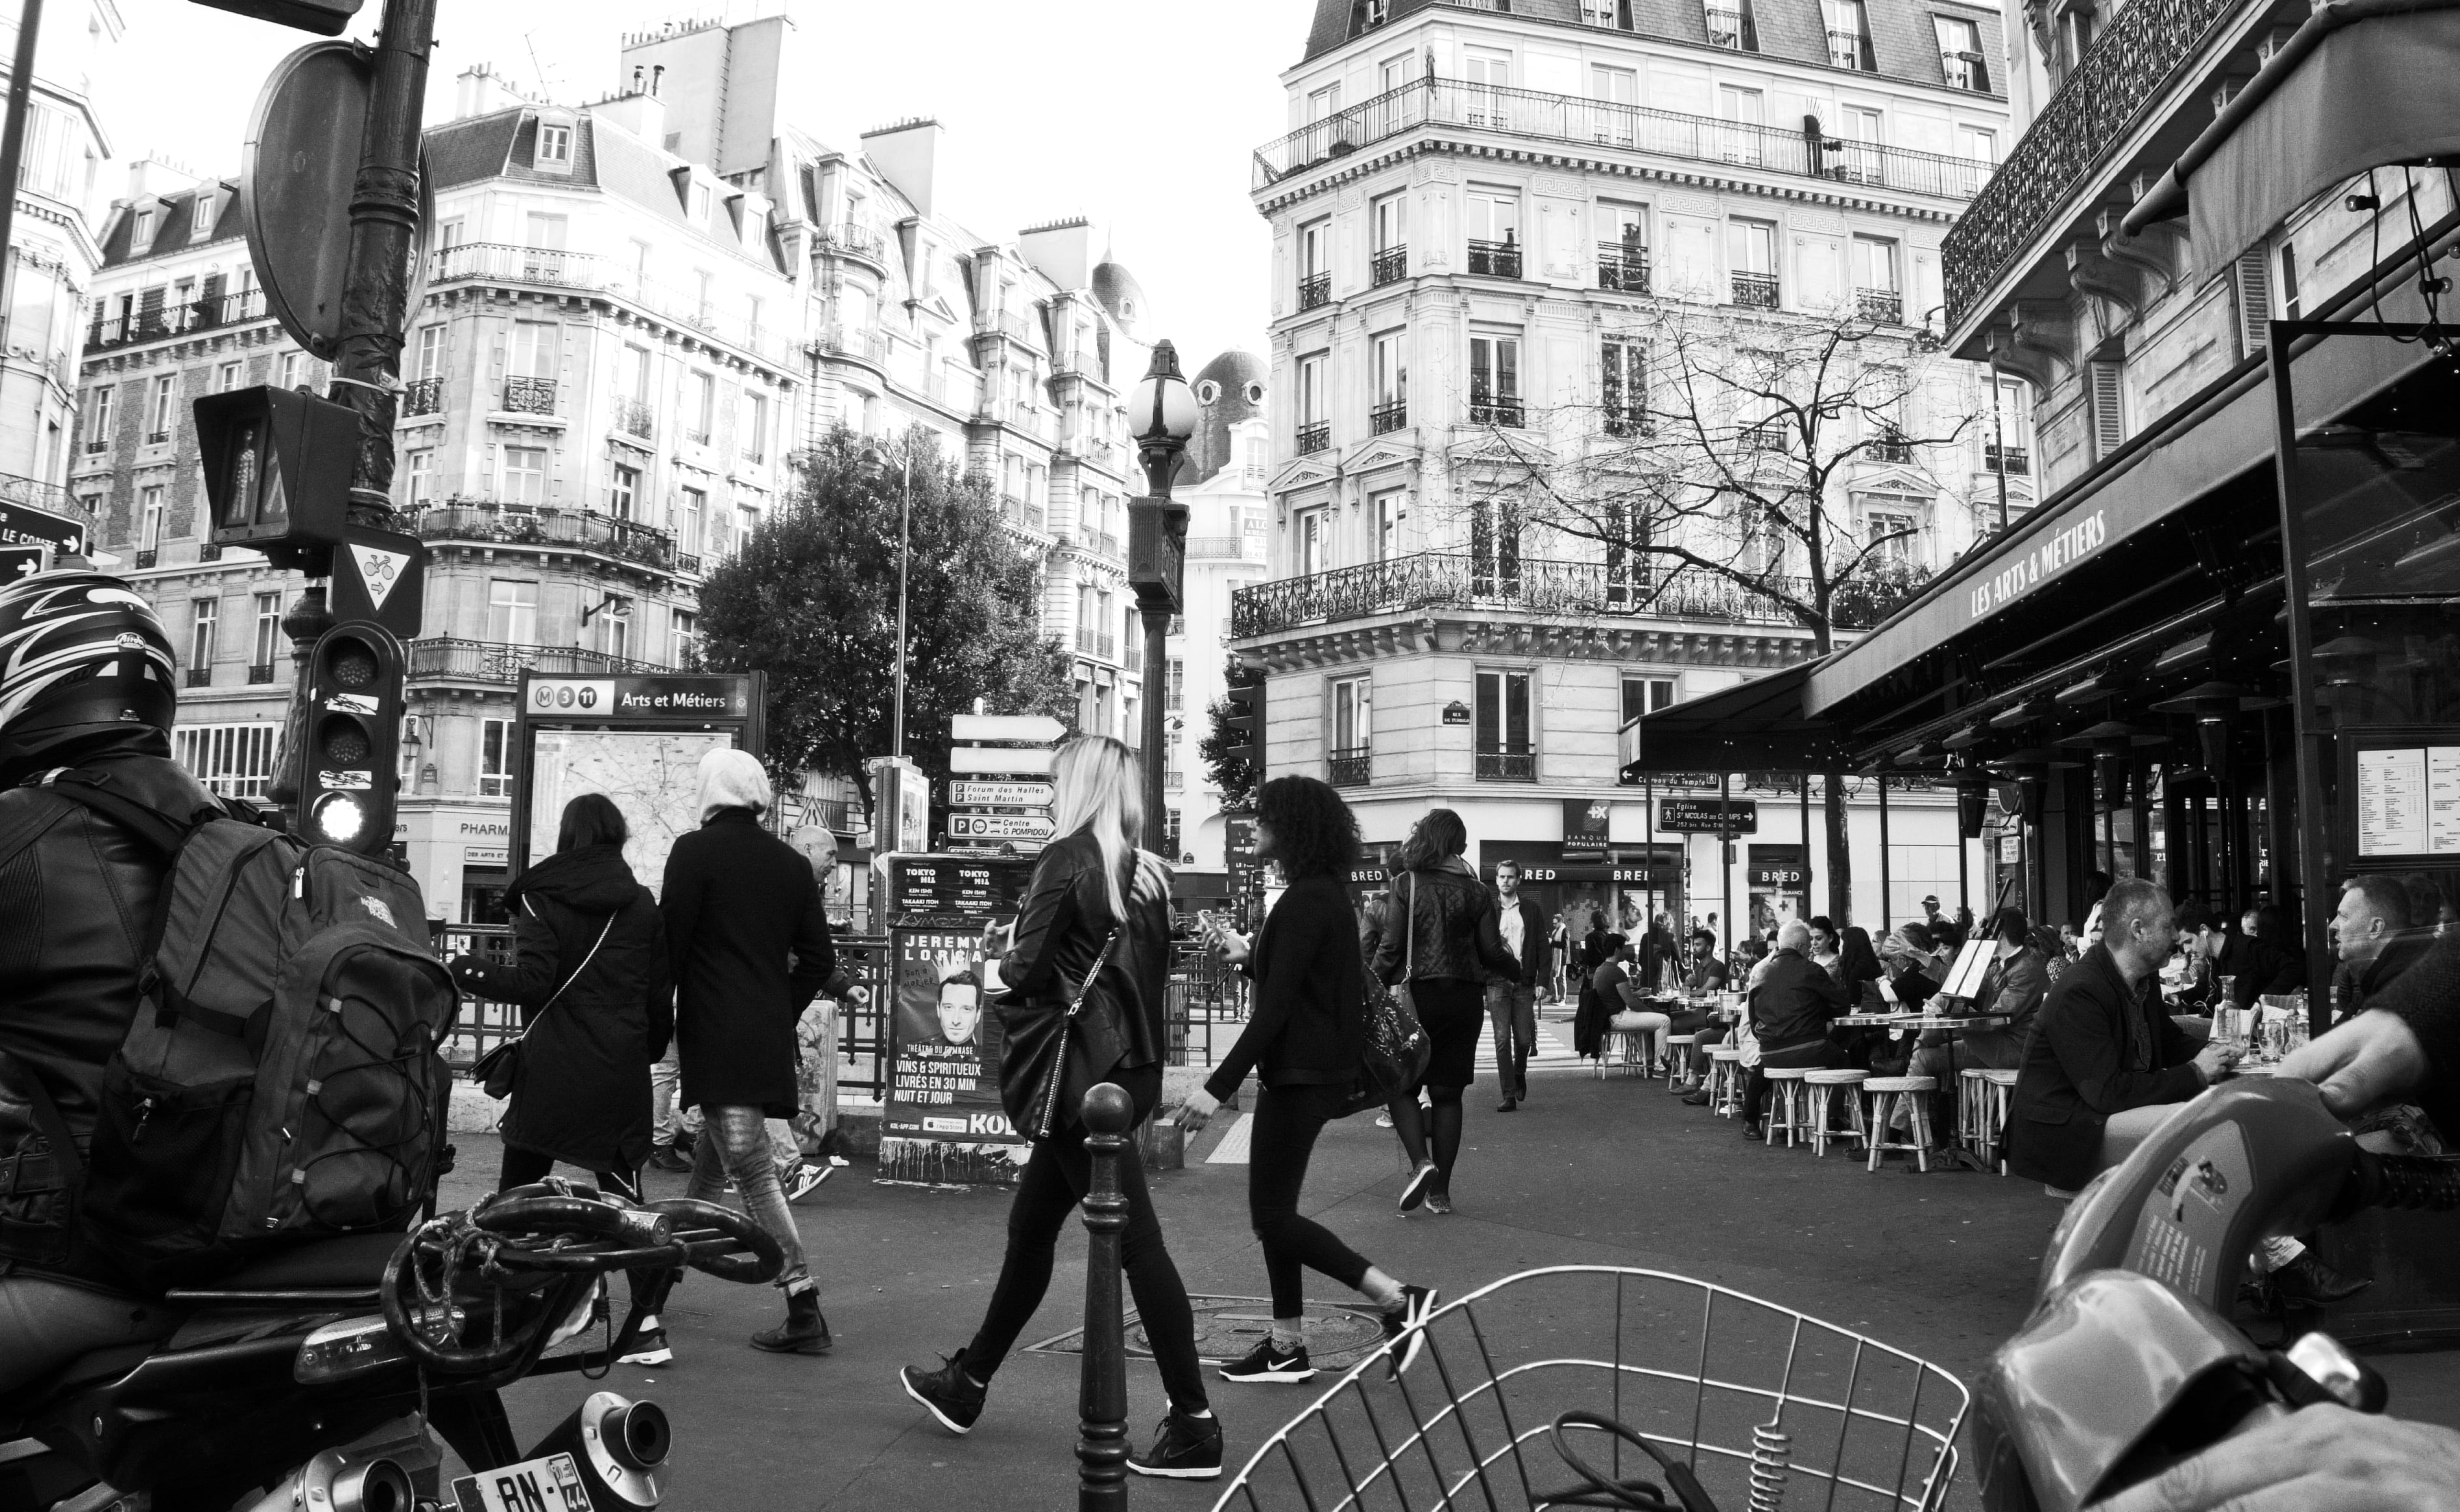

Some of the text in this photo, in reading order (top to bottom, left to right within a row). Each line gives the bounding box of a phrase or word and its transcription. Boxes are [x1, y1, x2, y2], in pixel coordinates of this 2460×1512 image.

[2, 528, 17, 542] LE
[1971, 509, 2106, 618] LES ARTS & MÉTIERS
[539, 691, 726, 708] M 3 11 Arts et Métiers
[1682, 778, 1706, 787] Temple
[1676, 803, 1697, 811] Eglise
[460, 823, 509, 835] PHARM
[958, 820, 967, 832] P
[959, 869, 990, 878] TOKYO
[1351, 870, 1383, 882] BRED
[1520, 869, 1556, 880] RED
[1762, 871, 1800, 882] BRED
[905, 935, 983, 949] JEREMY
[905, 949, 982, 962] LORCA
[944, 1046, 974, 1055] GYMNASE
[896, 1060, 982, 1076] VINS & SPIRITUEUX
[896, 1073, 976, 1091] LIVRÉS EN 30 MIN
[894, 1089, 953, 1104] NUIT ET JOUR
[970, 1113, 1017, 1136] KOL
[566, 1486, 587, 1511] 44
